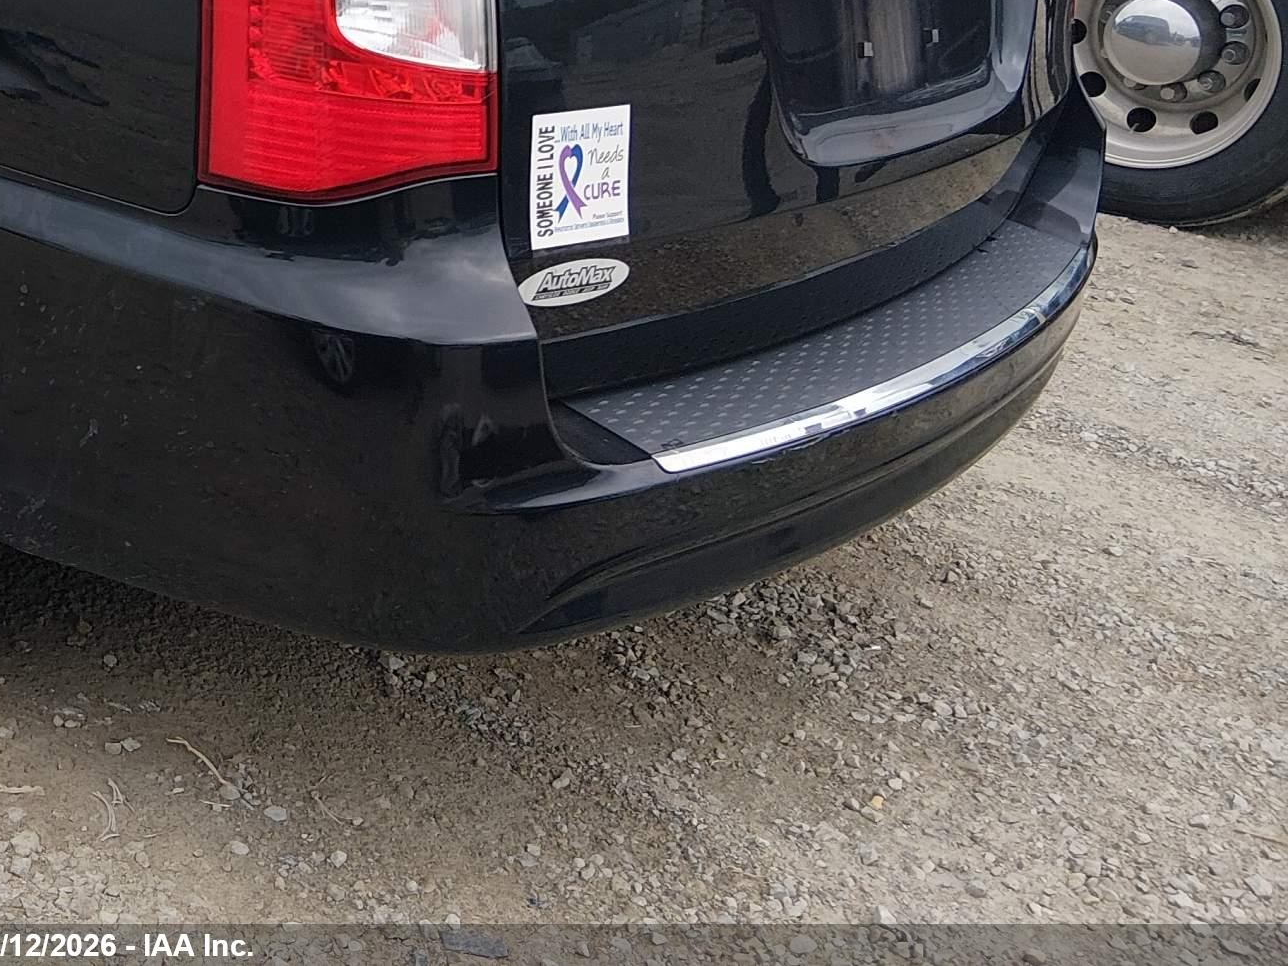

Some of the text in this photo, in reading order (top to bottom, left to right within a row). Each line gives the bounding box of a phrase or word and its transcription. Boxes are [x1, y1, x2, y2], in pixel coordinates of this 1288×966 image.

[537, 126, 556, 162] LOVE
[579, 123, 590, 140] All
[592, 122, 602, 143] My
[604, 121, 623, 137] Heart
[583, 180, 621, 200] CURE
[536, 172, 554, 238] SOMEONE
[537, 266, 616, 294] AutoMax
